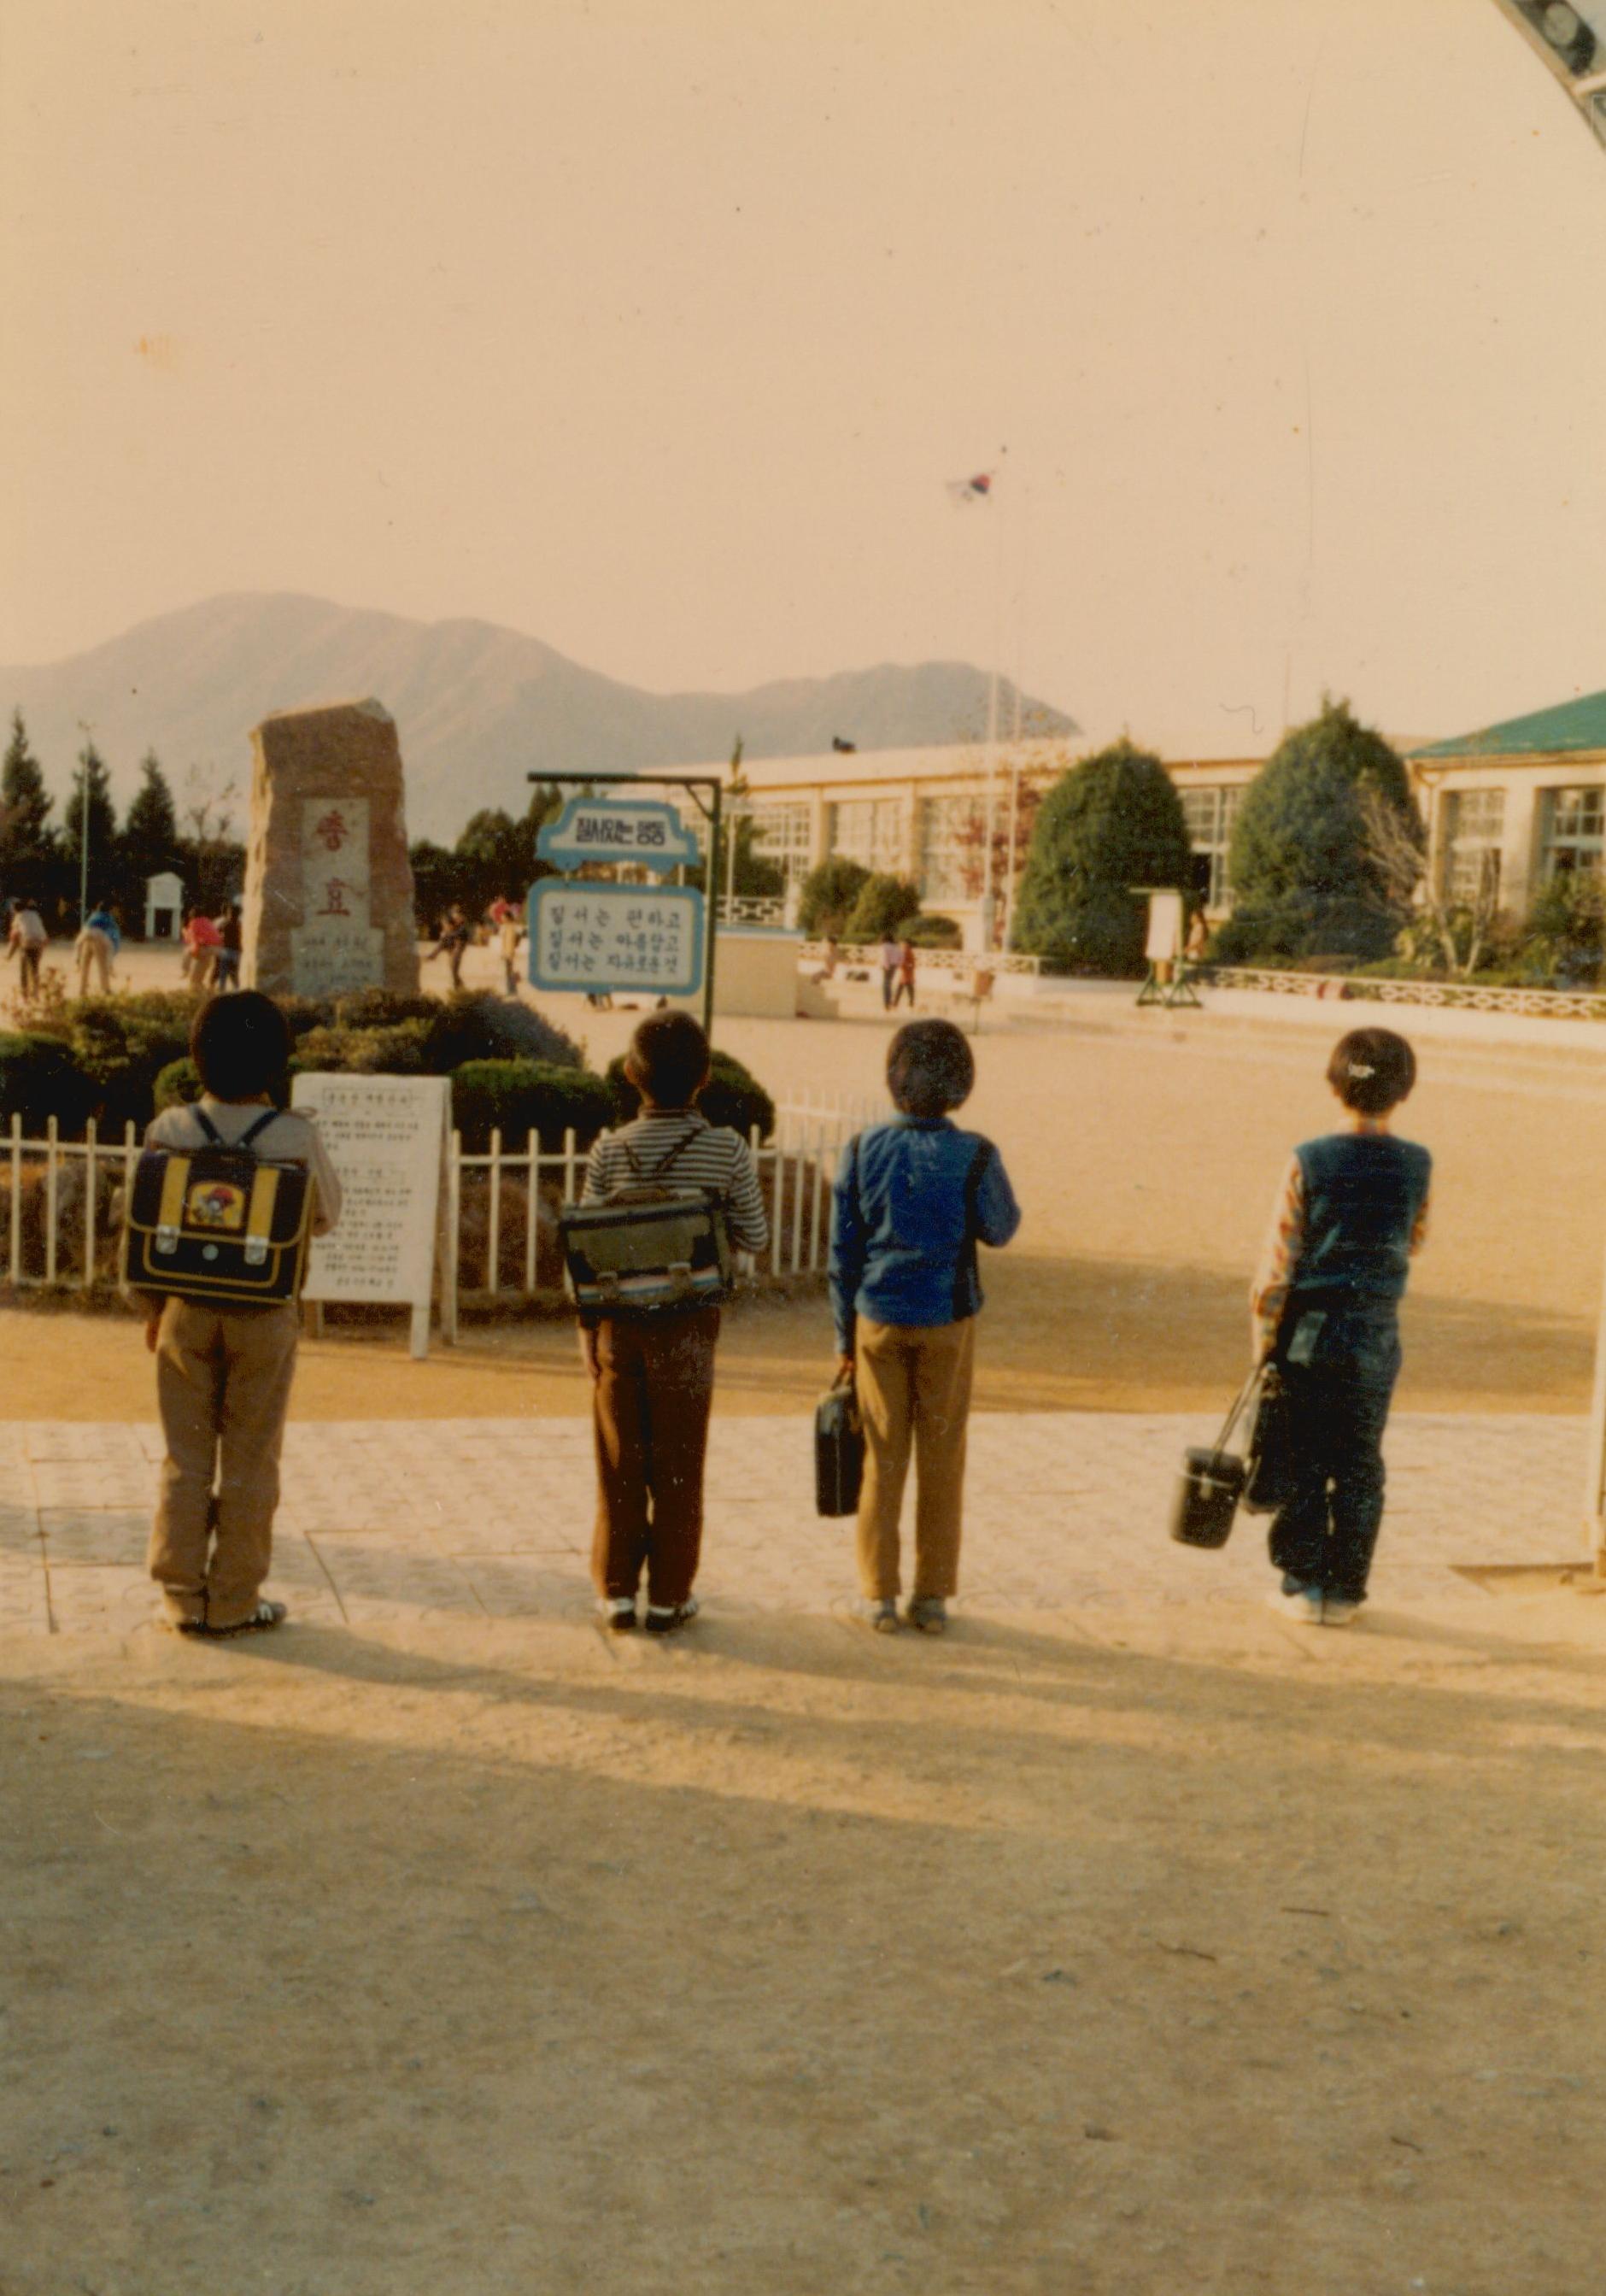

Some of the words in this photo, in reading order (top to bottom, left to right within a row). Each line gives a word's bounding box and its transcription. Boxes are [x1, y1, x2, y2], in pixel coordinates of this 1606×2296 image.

[550, 904, 611, 927] 질서는
[626, 908, 681, 930] 편하고
[549, 930, 605, 950] 질서는
[615, 931, 680, 953] 아름답고
[548, 951, 596, 972] 질서는
